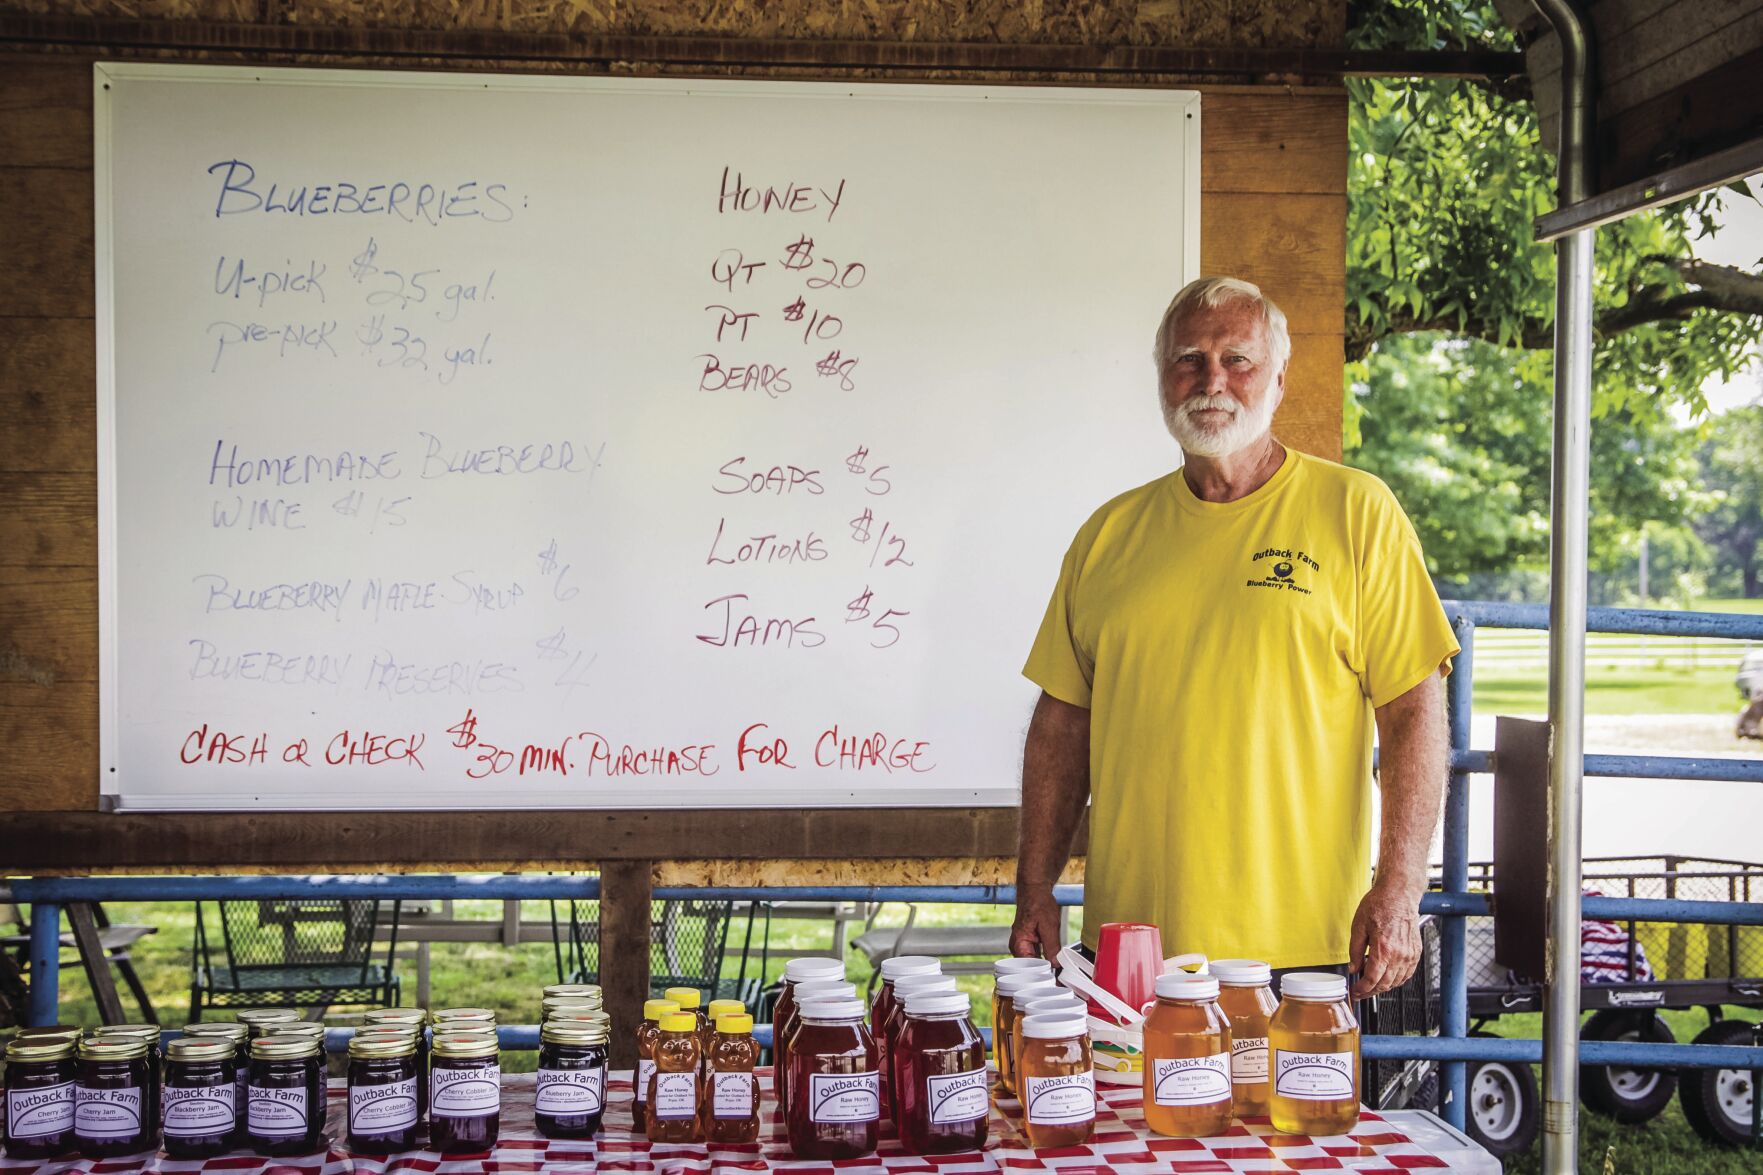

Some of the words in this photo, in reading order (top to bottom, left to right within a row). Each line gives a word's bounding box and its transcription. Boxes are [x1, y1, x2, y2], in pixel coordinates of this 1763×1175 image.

[718, 166, 846, 222] HONEY
[712, 247, 767, 293] QT
[779, 233, 866, 289] $20
[349, 237, 441, 310] $25
[435, 269, 495, 321] gal.
[705, 304, 760, 342] PT
[783, 295, 843, 344] $10
[356, 314, 428, 370] $32
[437, 332, 494, 385] gal.
[693, 353, 792, 399] BEARS
[816, 349, 859, 392] $8
[209, 439, 401, 488] HOMEMADE
[418, 431, 606, 480] BLUEBERRY
[712, 456, 824, 495] SOAPS
[846, 444, 891, 495] $5
[212, 496, 306, 530] WINE
[332, 489, 412, 534] $15
[707, 517, 829, 565] LOTIONS
[849, 506, 914, 568] $12
[1252, 548, 1293, 561] Outback
[1297, 551, 1320, 572] Farm
[193, 573, 351, 623] BLUEBERRY
[453, 570, 525, 616] SYRUP
[538, 538, 580, 602] $6
[1247, 580, 1284, 590] Blueberry
[1287, 583, 1313, 596] Power
[696, 594, 826, 648] JAMS
[845, 584, 911, 648] $5
[189, 639, 351, 687] BLUEBERRY
[365, 647, 525, 701] PRESERVES
[180, 723, 268, 767] CASH
[325, 730, 425, 771] CHECK
[446, 708, 514, 779] $30
[519, 736, 575, 777] MIN.
[579, 732, 720, 777] PURCHASE
[738, 723, 797, 772] FOR
[814, 724, 937, 774] CHARGE
[1159, 1058, 1200, 1076] Outback
[1203, 1056, 1225, 1071] Farm
[1281, 1055, 1322, 1069] Outback
[1325, 1055, 1347, 1070] Farm
[436, 1069, 480, 1085] Outback
[537, 1073, 570, 1086] Outback
[574, 1073, 599, 1086] Farm
[658, 1074, 681, 1088] Outback
[681, 1075, 693, 1088] Farm
[716, 1074, 738, 1088] Outback
[738, 1075, 751, 1088] Farm
[821, 1078, 863, 1098] Outback
[937, 1075, 976, 1098] Outback
[1032, 1076, 1073, 1095] Outback
[13, 1090, 62, 1112] Outback
[65, 1088, 76, 1098] Fa
[111, 1091, 139, 1106] Farm
[165, 1088, 204, 1102] Outback
[208, 1087, 233, 1100] Farm
[275, 1089, 303, 1103] Farm
[353, 1085, 398, 1105] Outback
[37, 1110, 59, 1118] Cherry
